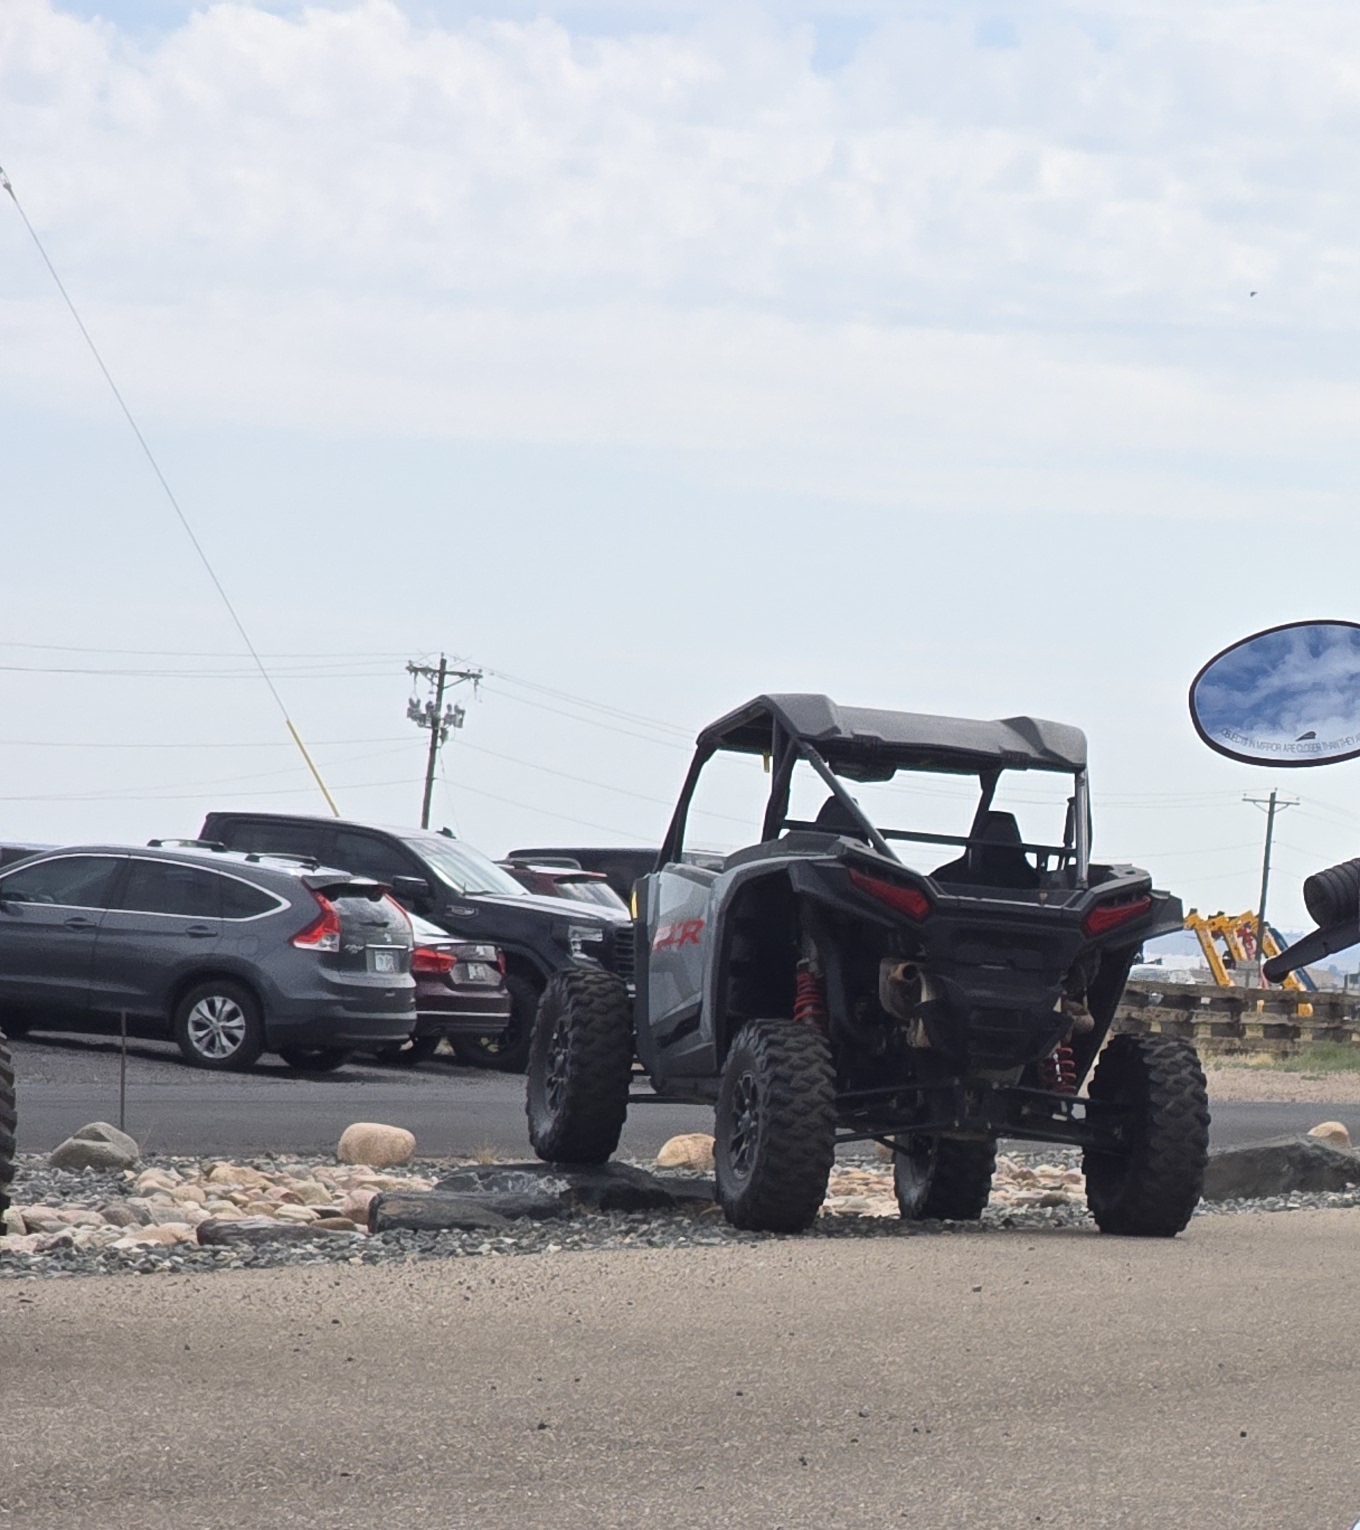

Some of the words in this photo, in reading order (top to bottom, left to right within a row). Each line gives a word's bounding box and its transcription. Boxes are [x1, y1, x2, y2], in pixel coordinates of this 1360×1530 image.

[1220, 727, 1249, 746] OBJECTS
[1256, 741, 1282, 753] MIRROR
[1283, 742, 1296, 753] ARE
[1296, 742, 1322, 754] CLOSER
